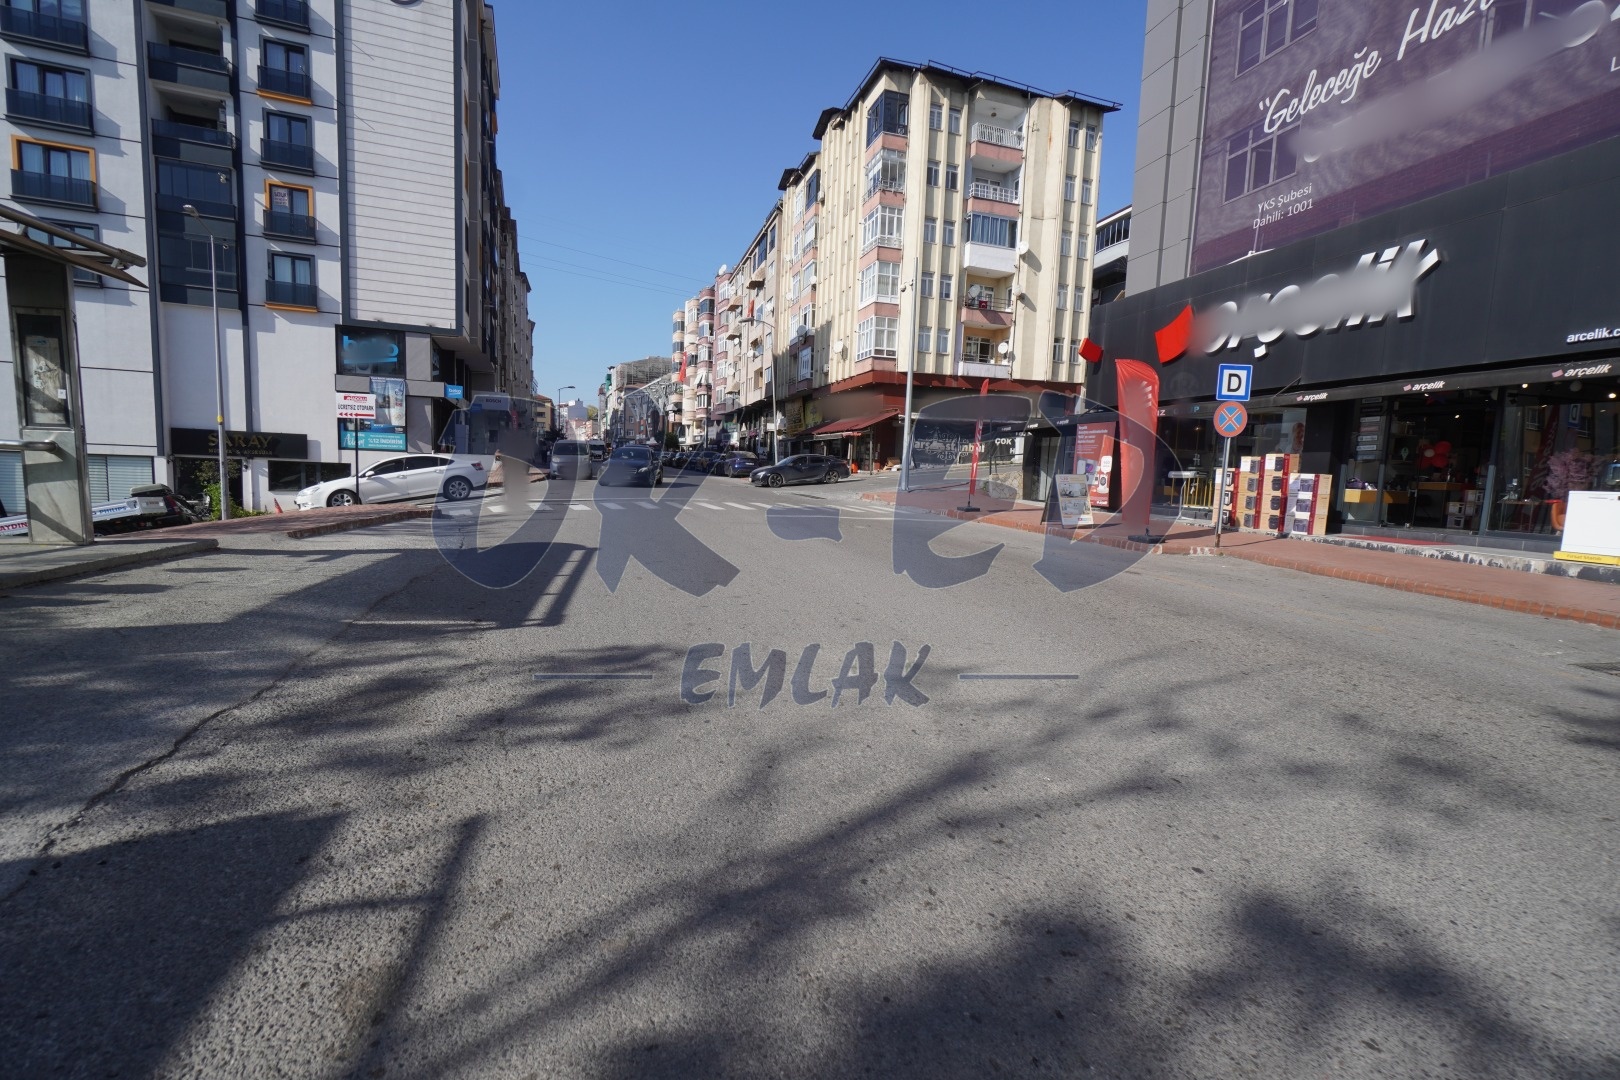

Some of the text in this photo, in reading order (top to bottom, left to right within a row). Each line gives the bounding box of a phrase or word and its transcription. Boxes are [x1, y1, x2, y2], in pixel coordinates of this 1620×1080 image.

[1257, 183, 1313, 212] YKS Şubesi
[1287, 199, 1313, 217] 1001
[1564, 364, 1612, 378] arçelik
[1227, 373, 1242, 393] D
[1412, 380, 1446, 391] arçelik
[1303, 392, 1329, 402] arçelik
[208, 432, 273, 448] SARAY
[99, 506, 127, 514] PHILIPS
